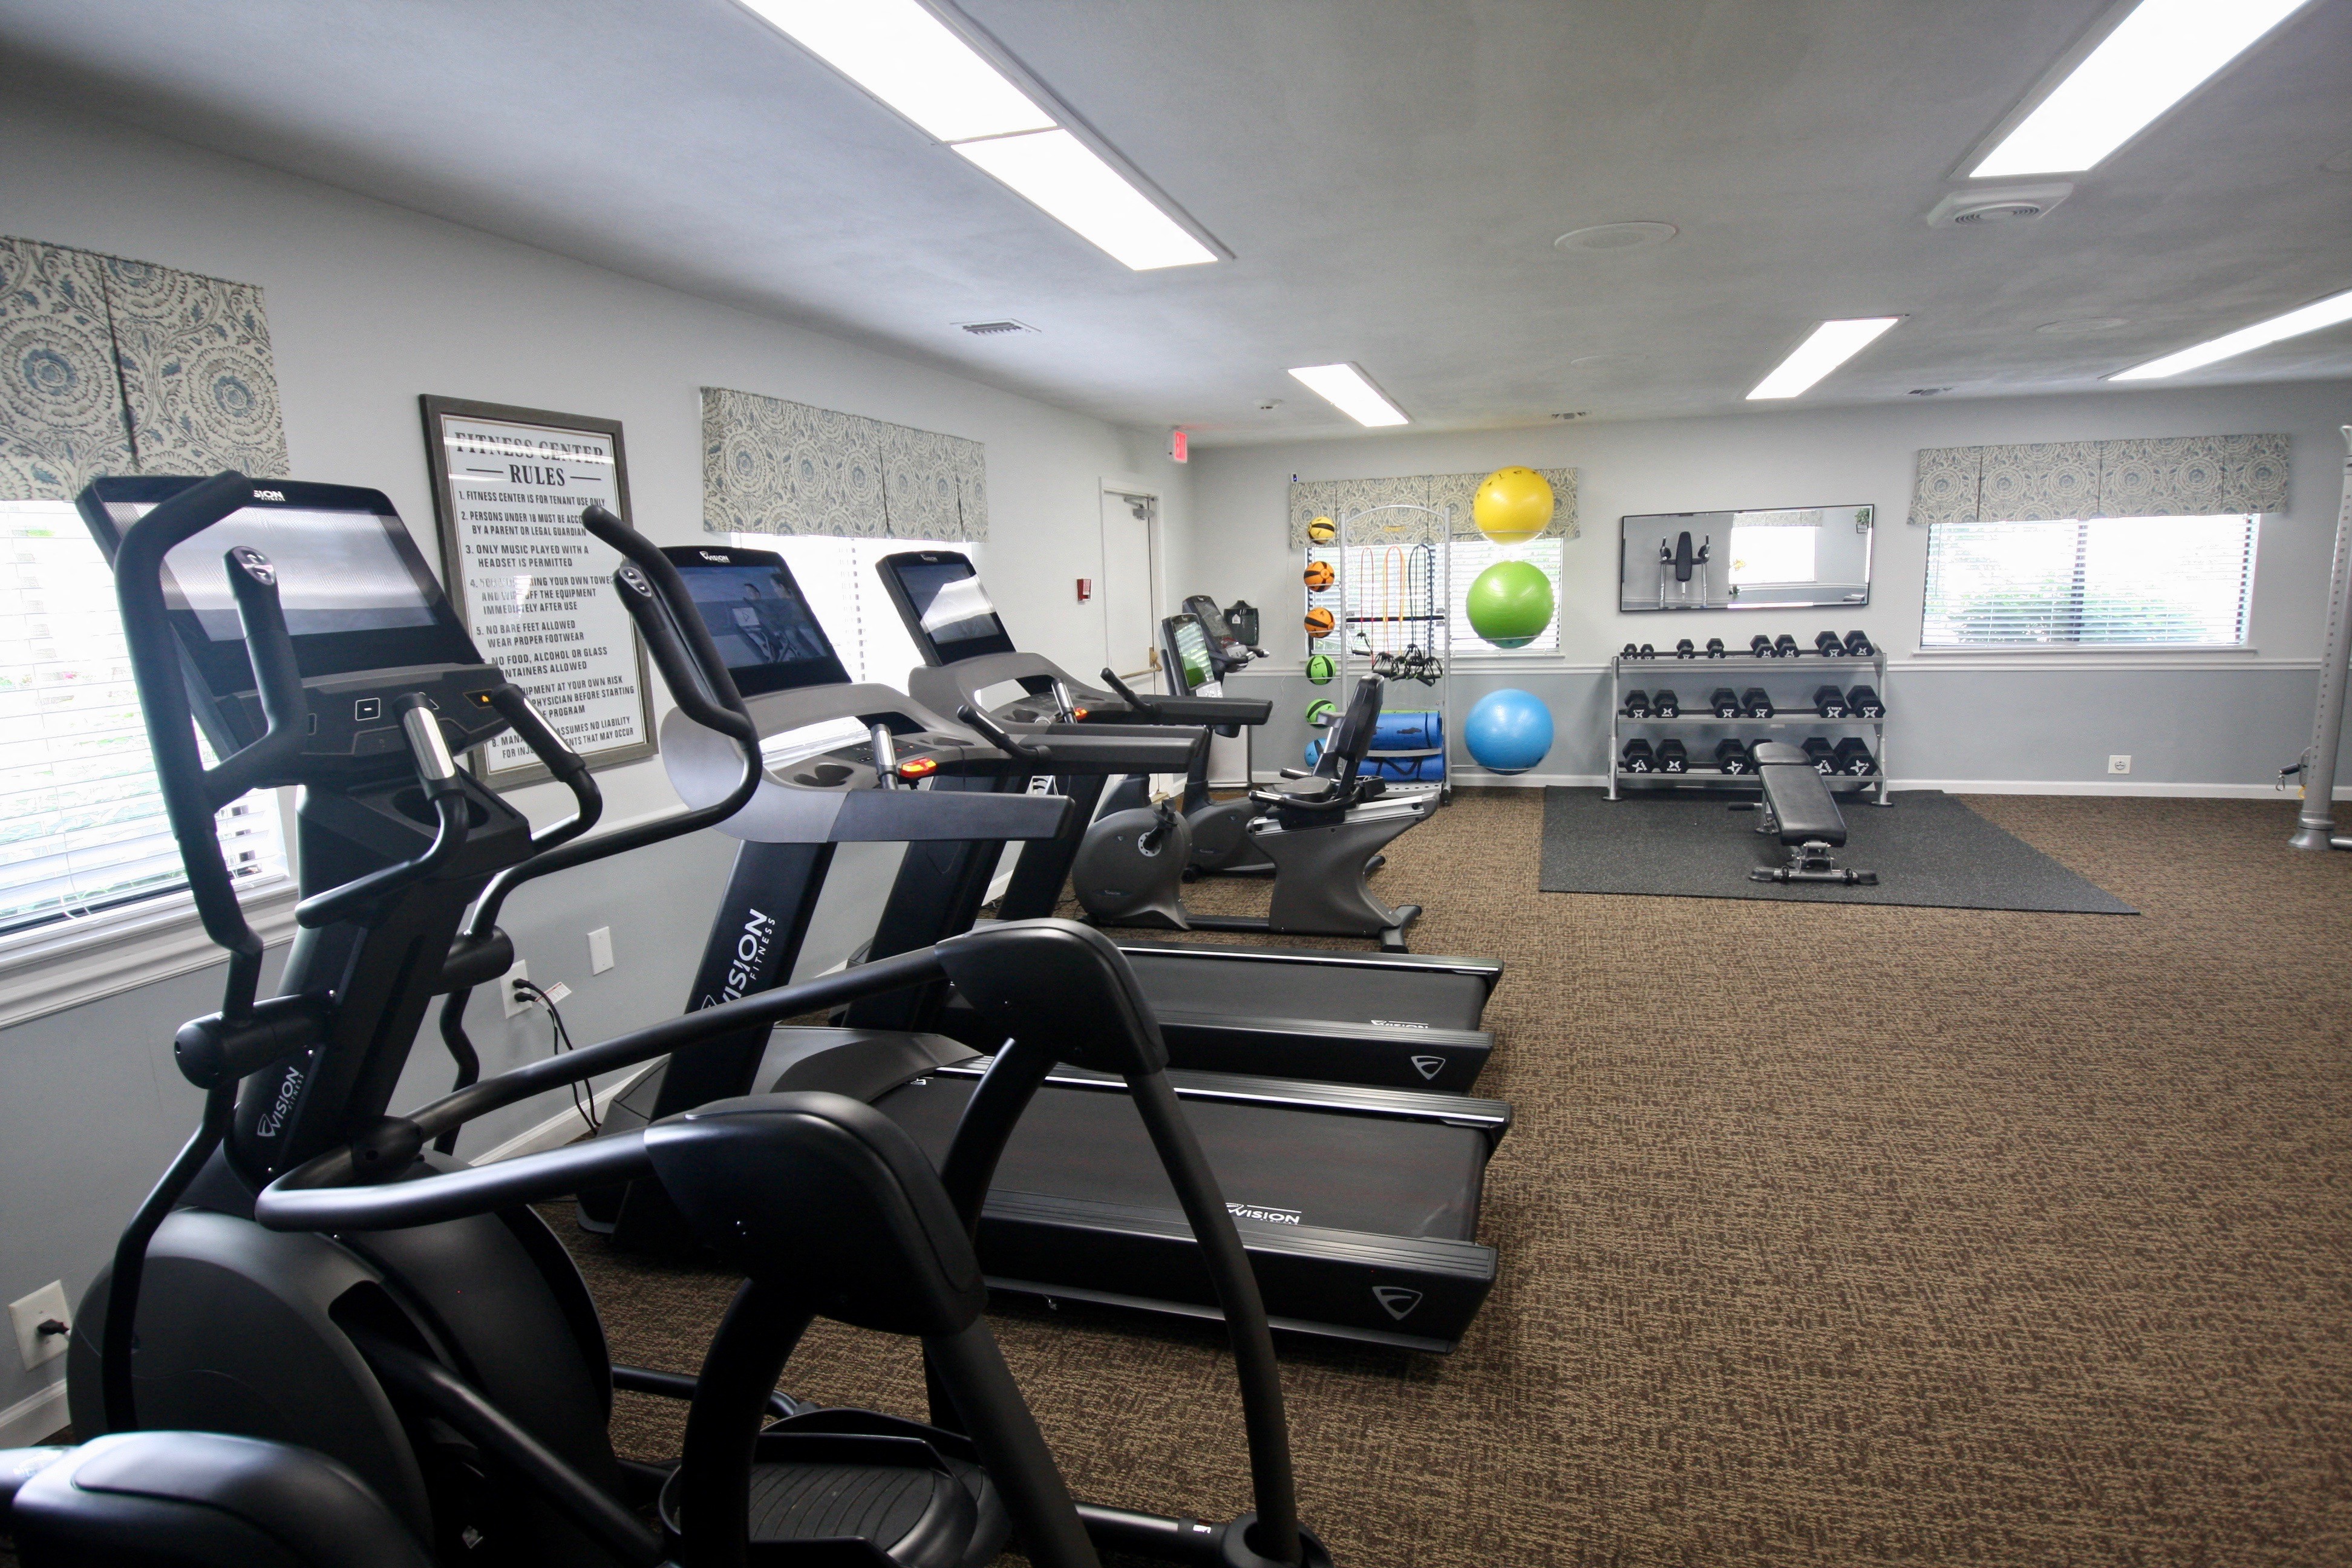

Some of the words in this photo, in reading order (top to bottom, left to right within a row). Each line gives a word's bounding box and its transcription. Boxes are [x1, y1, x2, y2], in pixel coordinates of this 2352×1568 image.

[455, 432, 533, 459] FITNESS
[539, 441, 604, 465] CENTER
[509, 464, 565, 486] RULES
[253, 489, 284, 499] SION
[459, 491, 465, 500] 1.
[467, 491, 497, 501] FITNESS
[498, 493, 525, 503] CENTER
[528, 495, 534, 503] IS
[536, 495, 547, 504] FOR
[550, 495, 575, 505] TENANT
[577, 497, 588, 506] USE
[590, 498, 605, 506] ONLY
[462, 511, 468, 520] 2.
[470, 511, 503, 521] PERSONS
[505, 512, 527, 522] UNDER
[530, 514, 536, 522] 18
[538, 514, 555, 523] MUST
[558, 515, 565, 523] BE
[472, 525, 482, 534] BY
[485, 525, 489, 534] A
[491, 526, 518, 535] PARENT
[520, 527, 529, 535] OR
[531, 527, 551, 535] LEGAL
[553, 528, 586, 536] GUARDIAN
[466, 545, 474, 554] 3.
[476, 544, 498, 554] ONLY
[501, 544, 528, 554] MUSIC
[531, 545, 560, 554] PLAYED
[561, 545, 582, 554] WITH
[584, 545, 589, 554] A
[479, 558, 515, 567] HEADSET
[518, 558, 526, 567] IS
[529, 558, 572, 567] PERMITTED
[550, 577, 569, 585] YOUR
[570, 576, 588, 585] OWN
[540, 590, 554, 599] THE
[555, 588, 596, 599] EQUIPMENT
[540, 603, 562, 612] AFTER
[564, 601, 577, 610] USE
[477, 626, 483, 635] 5.
[486, 625, 497, 634] NO
[500, 623, 520, 633] BARE
[523, 622, 539, 632] FEET
[542, 620, 575, 631] ALLOWED
[488, 637, 512, 648] WEAR
[514, 635, 543, 645] PROPER
[545, 632, 584, 643] FOOTWEAR
[491, 656, 504, 666] NO
[507, 654, 532, 664] FOOD,
[534, 650, 569, 662] ALCOHOL
[572, 648, 581, 658] OR
[584, 646, 607, 657] GLASS
[505, 665, 547, 678] NTAINERS
[550, 661, 587, 673] ALLOWED
[558, 682, 566, 691] AT
[568, 681, 586, 690] YOUR
[588, 678, 605, 687] OWN
[607, 675, 622, 685] RISK
[532, 695, 572, 707] PHYSICIAN
[575, 691, 600, 701] BEFORE
[602, 685, 634, 698] STARTING
[549, 705, 585, 718] PROGRAM
[590, 720, 599, 730] NO
[601, 716, 630, 728] LIABILITY
[583, 732, 598, 743] THAT
[599, 730, 613, 740] MAY
[615, 727, 633, 738] OCCUR
[503, 750, 515, 759] FOR
[750, 918, 776, 980] FITNESS
[270, 1067, 299, 1128] VISION
[1235, 1209, 1300, 1223] VISION
